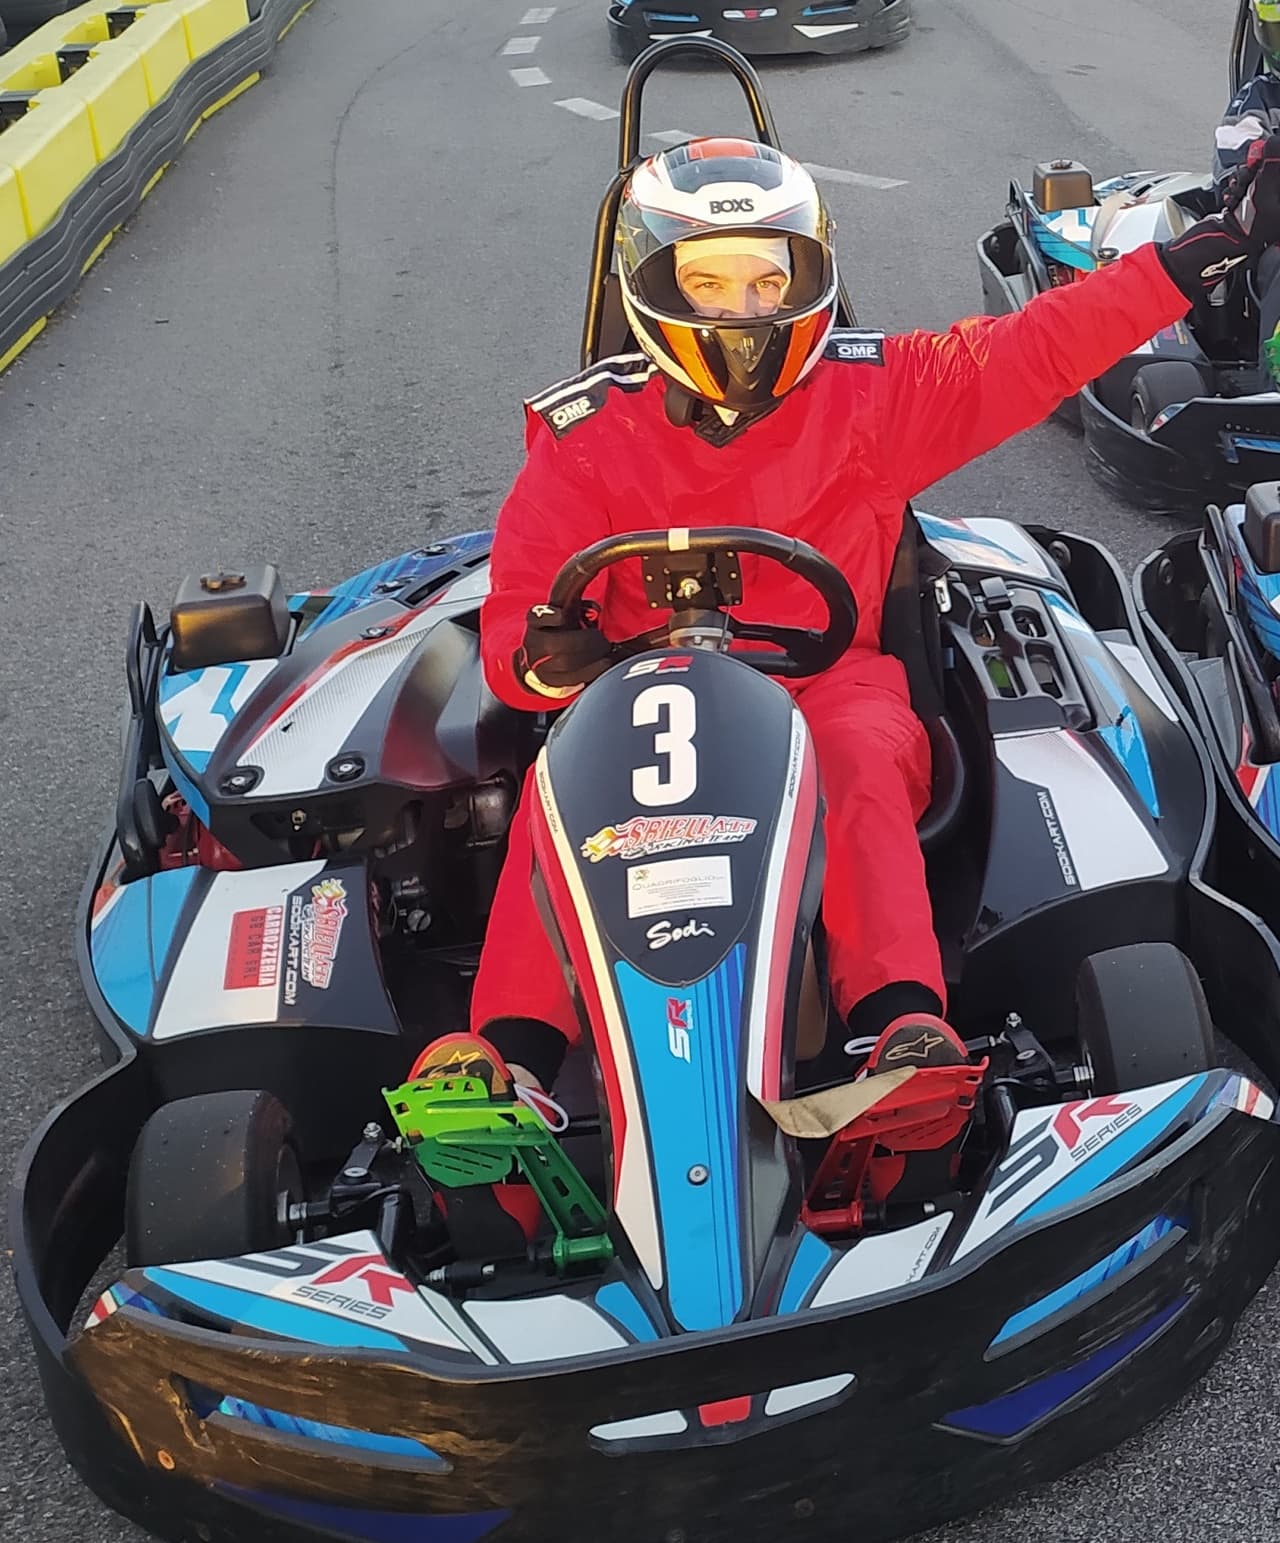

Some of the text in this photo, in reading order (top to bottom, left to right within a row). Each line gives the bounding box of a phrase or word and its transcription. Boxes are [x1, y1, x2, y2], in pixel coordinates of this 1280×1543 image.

[709, 197, 754, 215] BOXS
[837, 345, 877, 358] OMP
[552, 400, 591, 427] OMP
[632, 684, 697, 807] 3
[1037, 791, 1077, 886] SODIKART.COM
[246, 934, 262, 955] CAR
[258, 906, 283, 986] CARROZZERIA
[284, 895, 303, 1005] SODIKART.COM
[646, 919, 715, 949] Sodi
[1070, 1104, 1143, 1161] SERIES
[292, 1284, 393, 1321] SERIES
